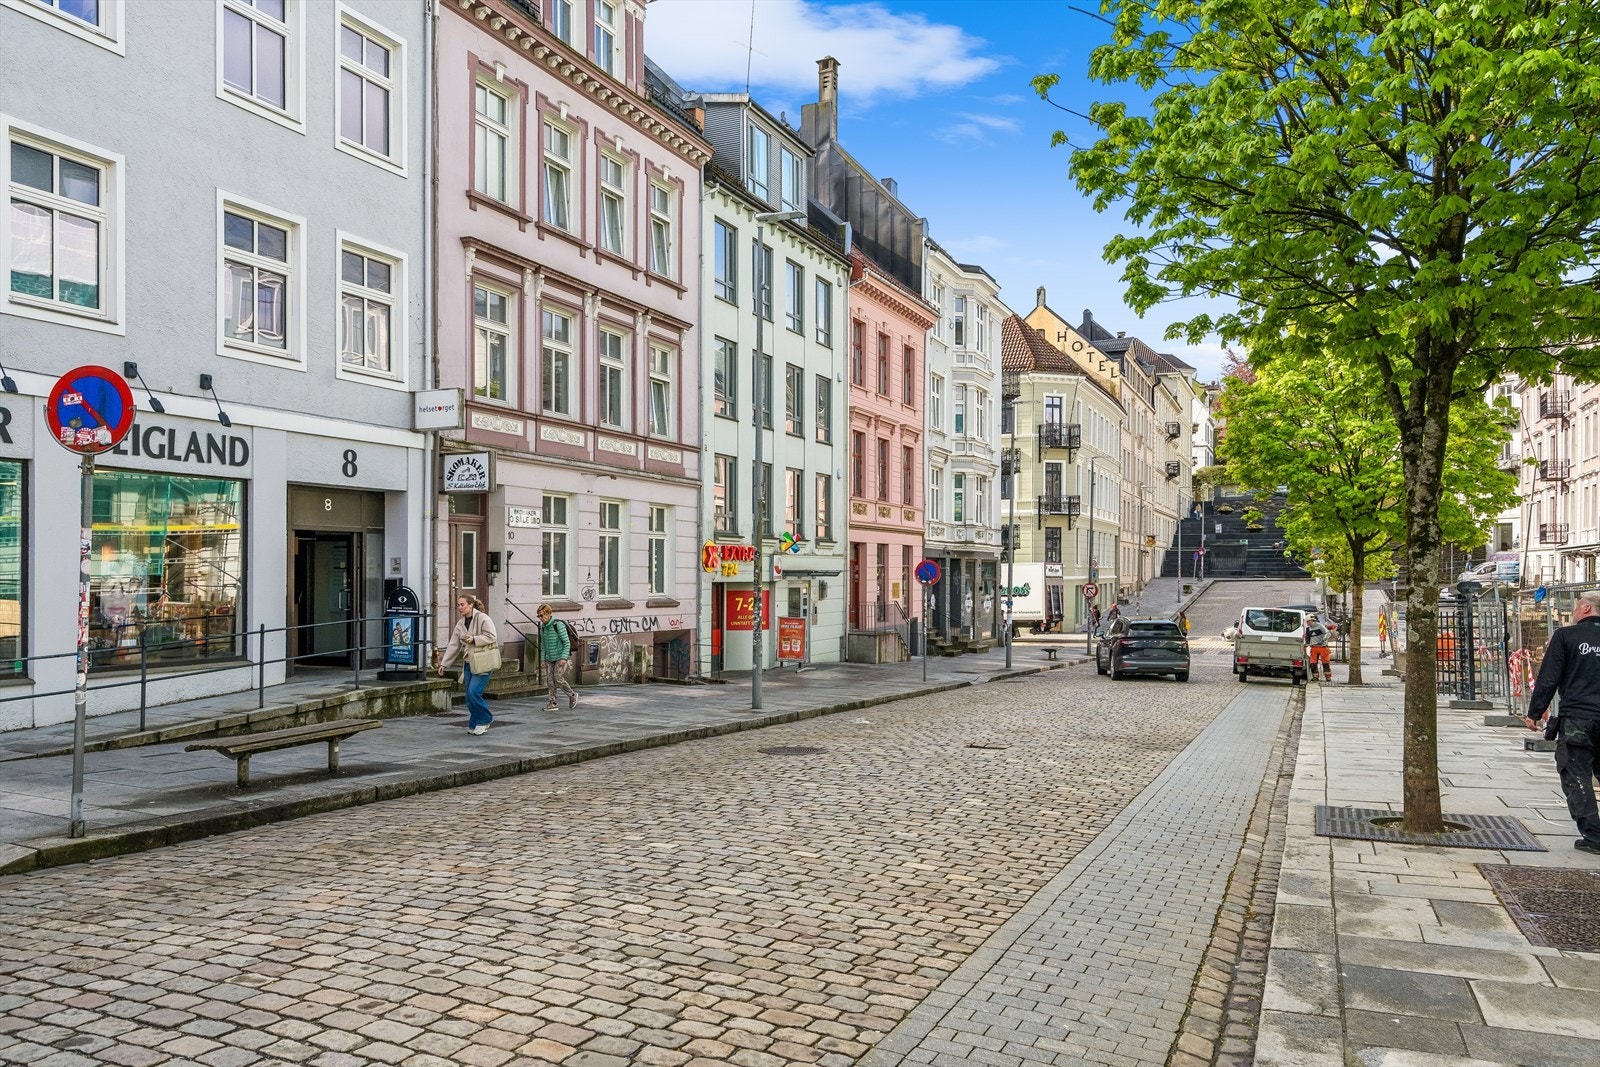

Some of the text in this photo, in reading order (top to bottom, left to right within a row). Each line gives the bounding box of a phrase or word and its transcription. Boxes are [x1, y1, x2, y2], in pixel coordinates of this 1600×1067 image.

[1057, 330, 1118, 379] HOTEL
[342, 449, 358, 478] 8
[446, 456, 486, 482] SKOMAKER
[324, 498, 332, 511] 8
[507, 531, 515, 540] 10
[721, 545, 755, 562] EXTRA
[735, 597, 754, 611] 7-2
